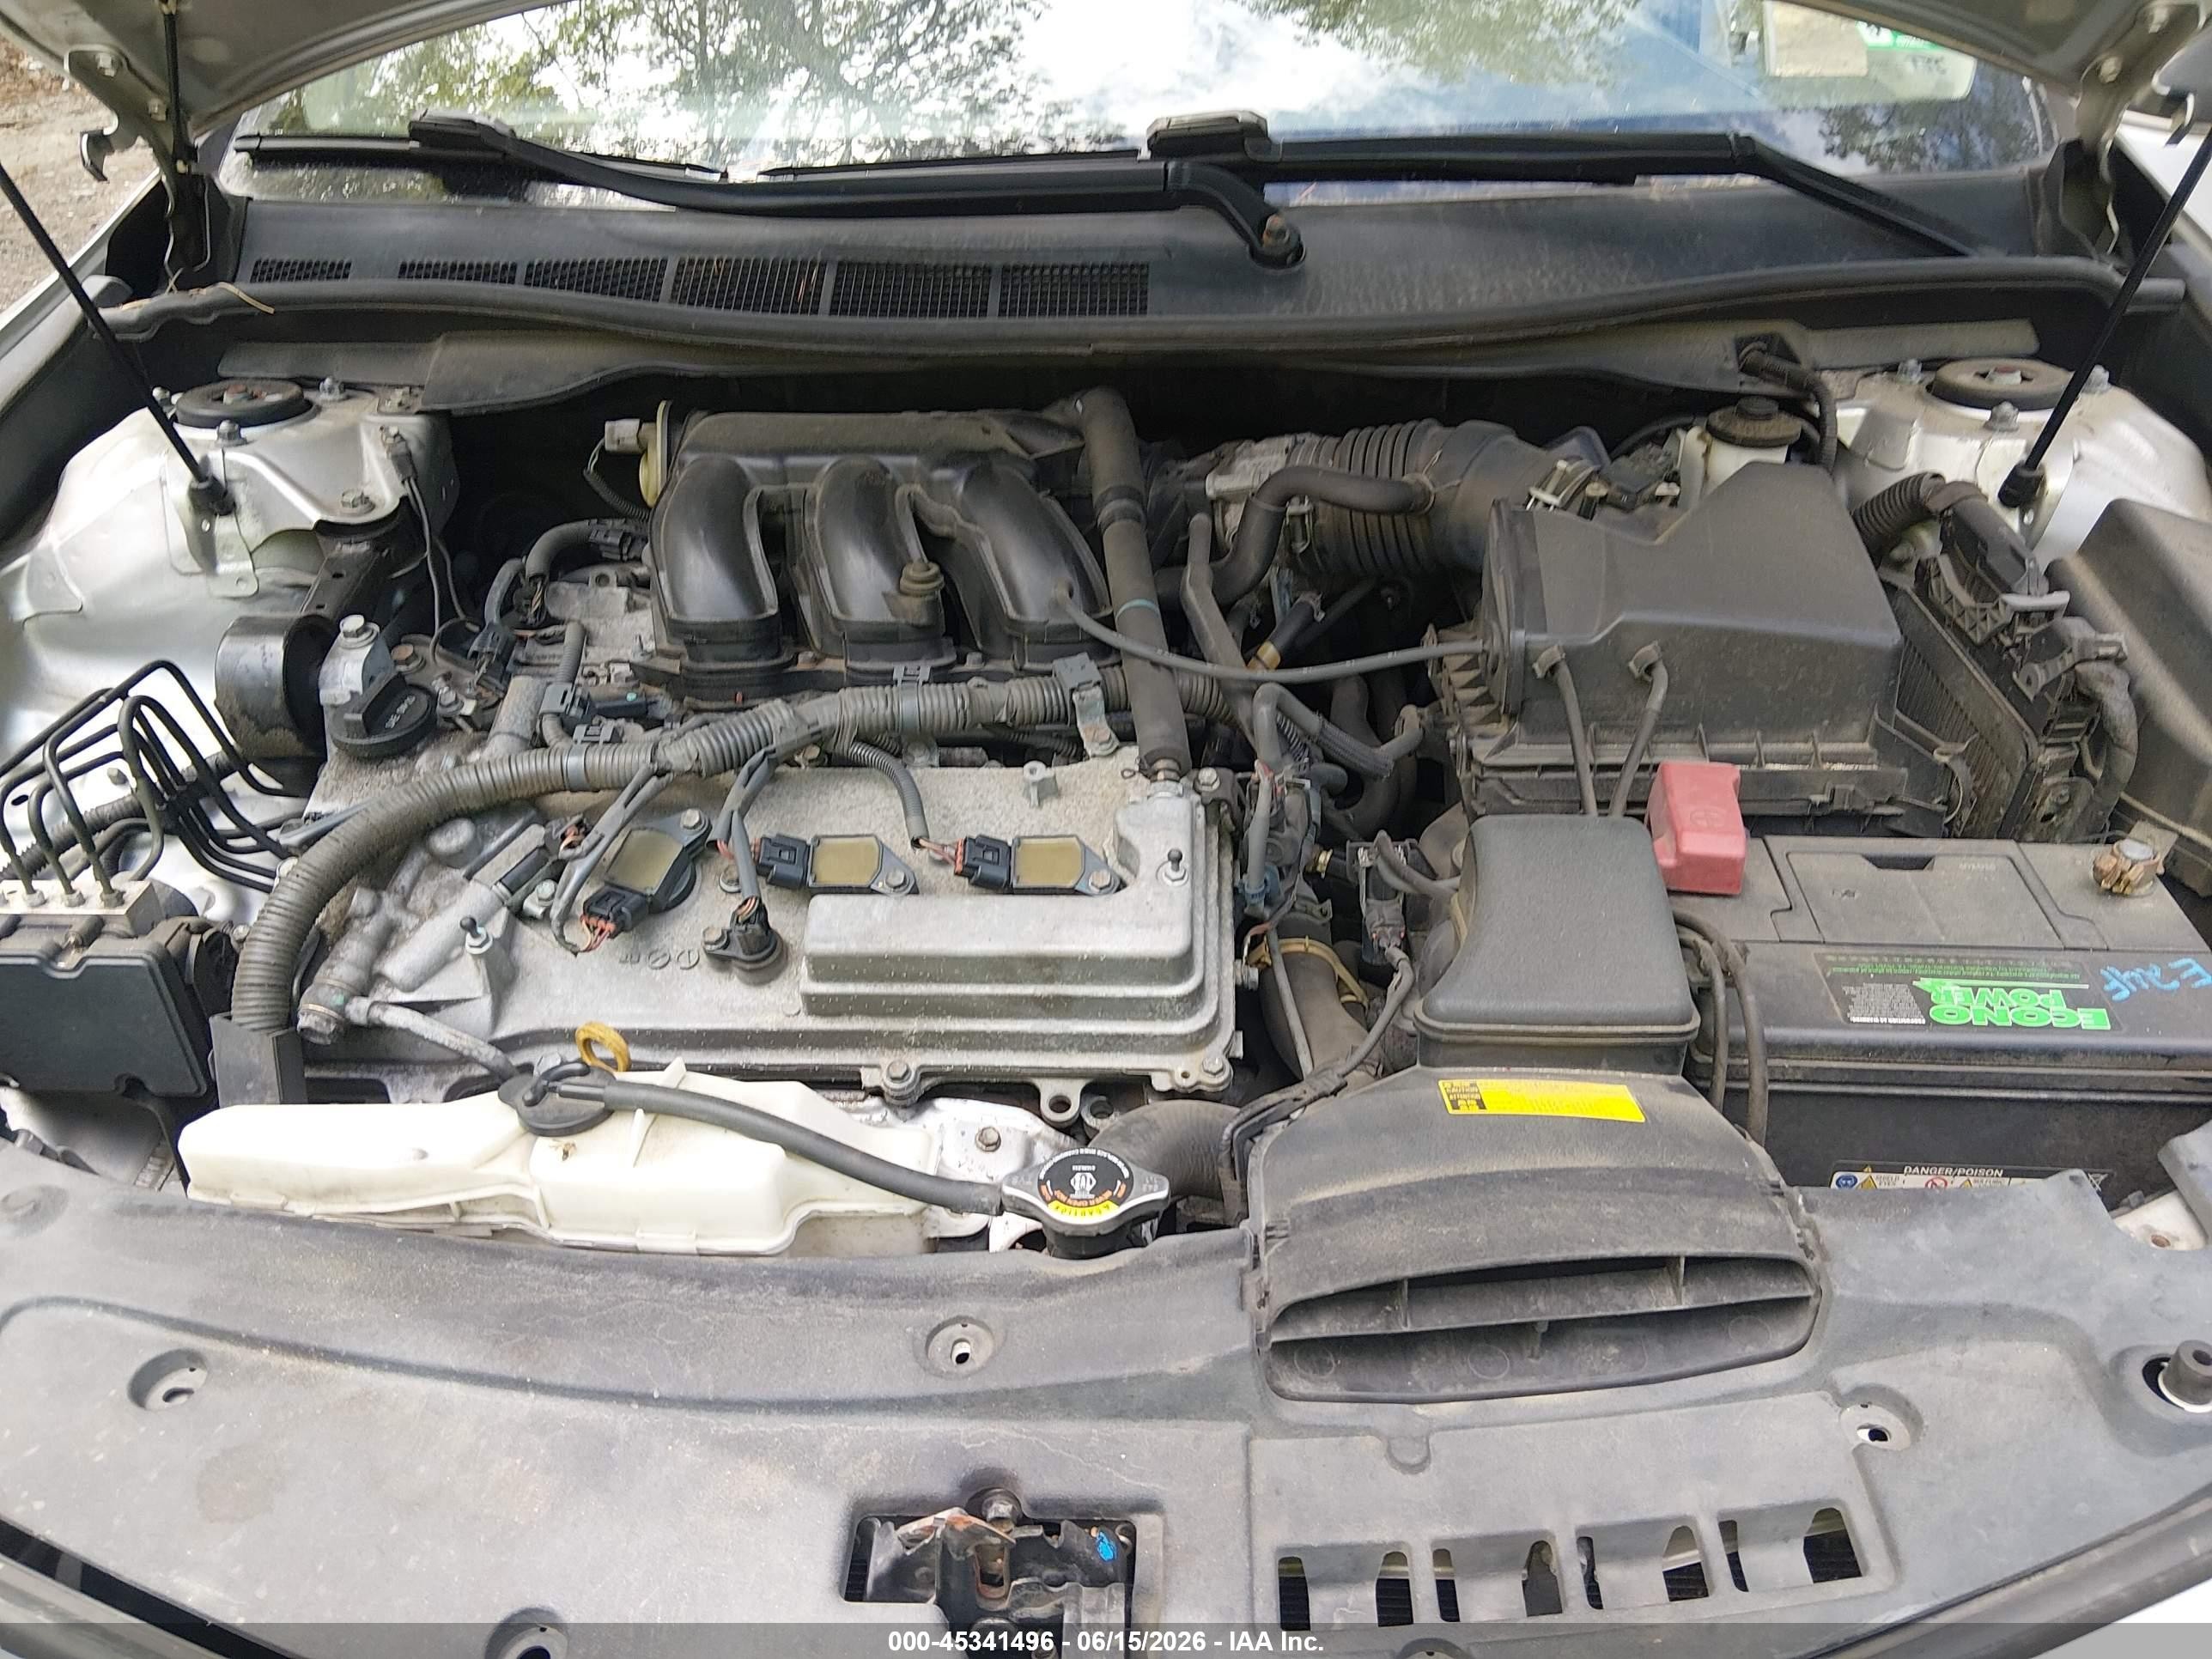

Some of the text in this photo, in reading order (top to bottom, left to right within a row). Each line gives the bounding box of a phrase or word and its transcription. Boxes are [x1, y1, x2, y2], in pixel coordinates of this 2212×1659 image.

[1931, 987, 2067, 1009] POWER
[1929, 1003, 2112, 1030] ECONO
[1904, 1166, 2003, 1178] DANGER/POISON
